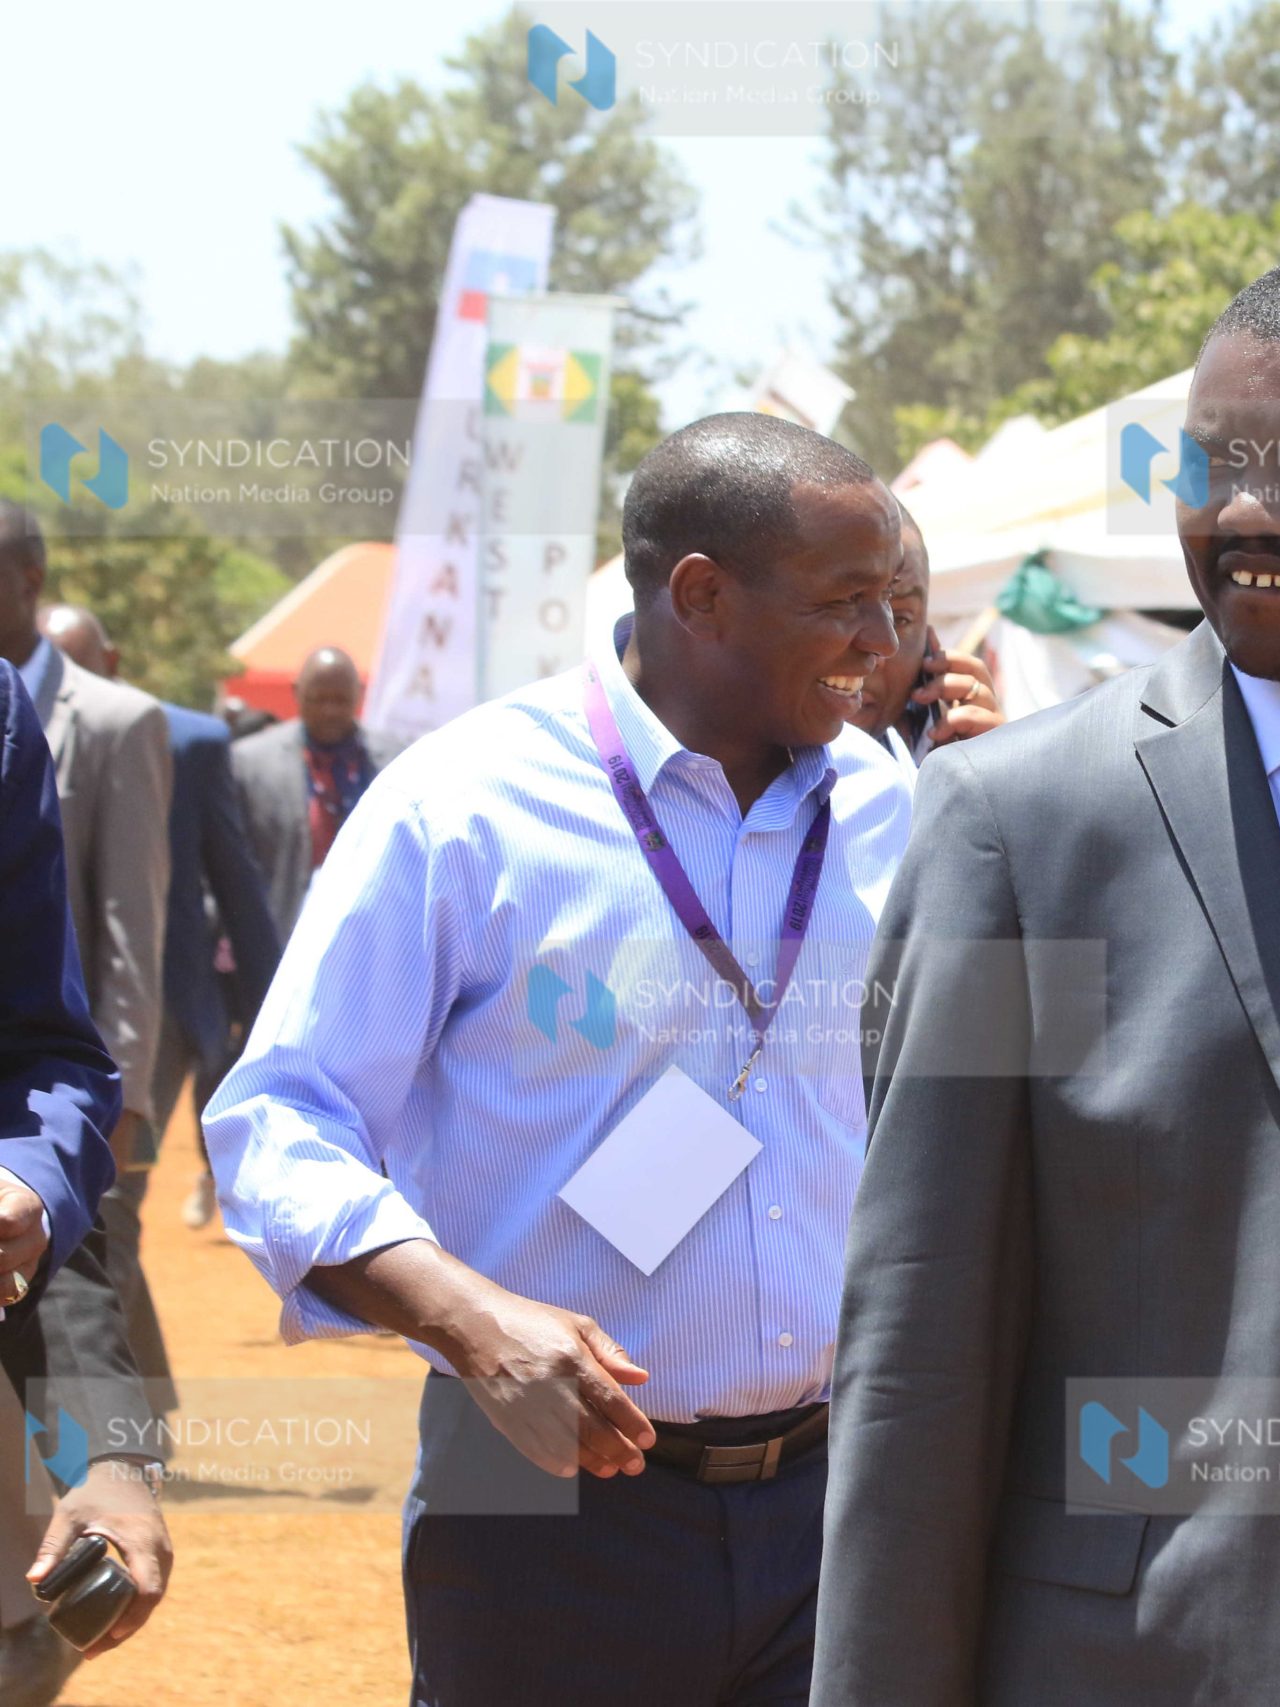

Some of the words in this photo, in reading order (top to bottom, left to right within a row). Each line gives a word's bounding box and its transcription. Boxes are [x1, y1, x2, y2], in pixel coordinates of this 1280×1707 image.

[483, 439, 524, 620] WEST
[608, 754, 630, 784] 2019
[789, 901, 807, 931] 2019
